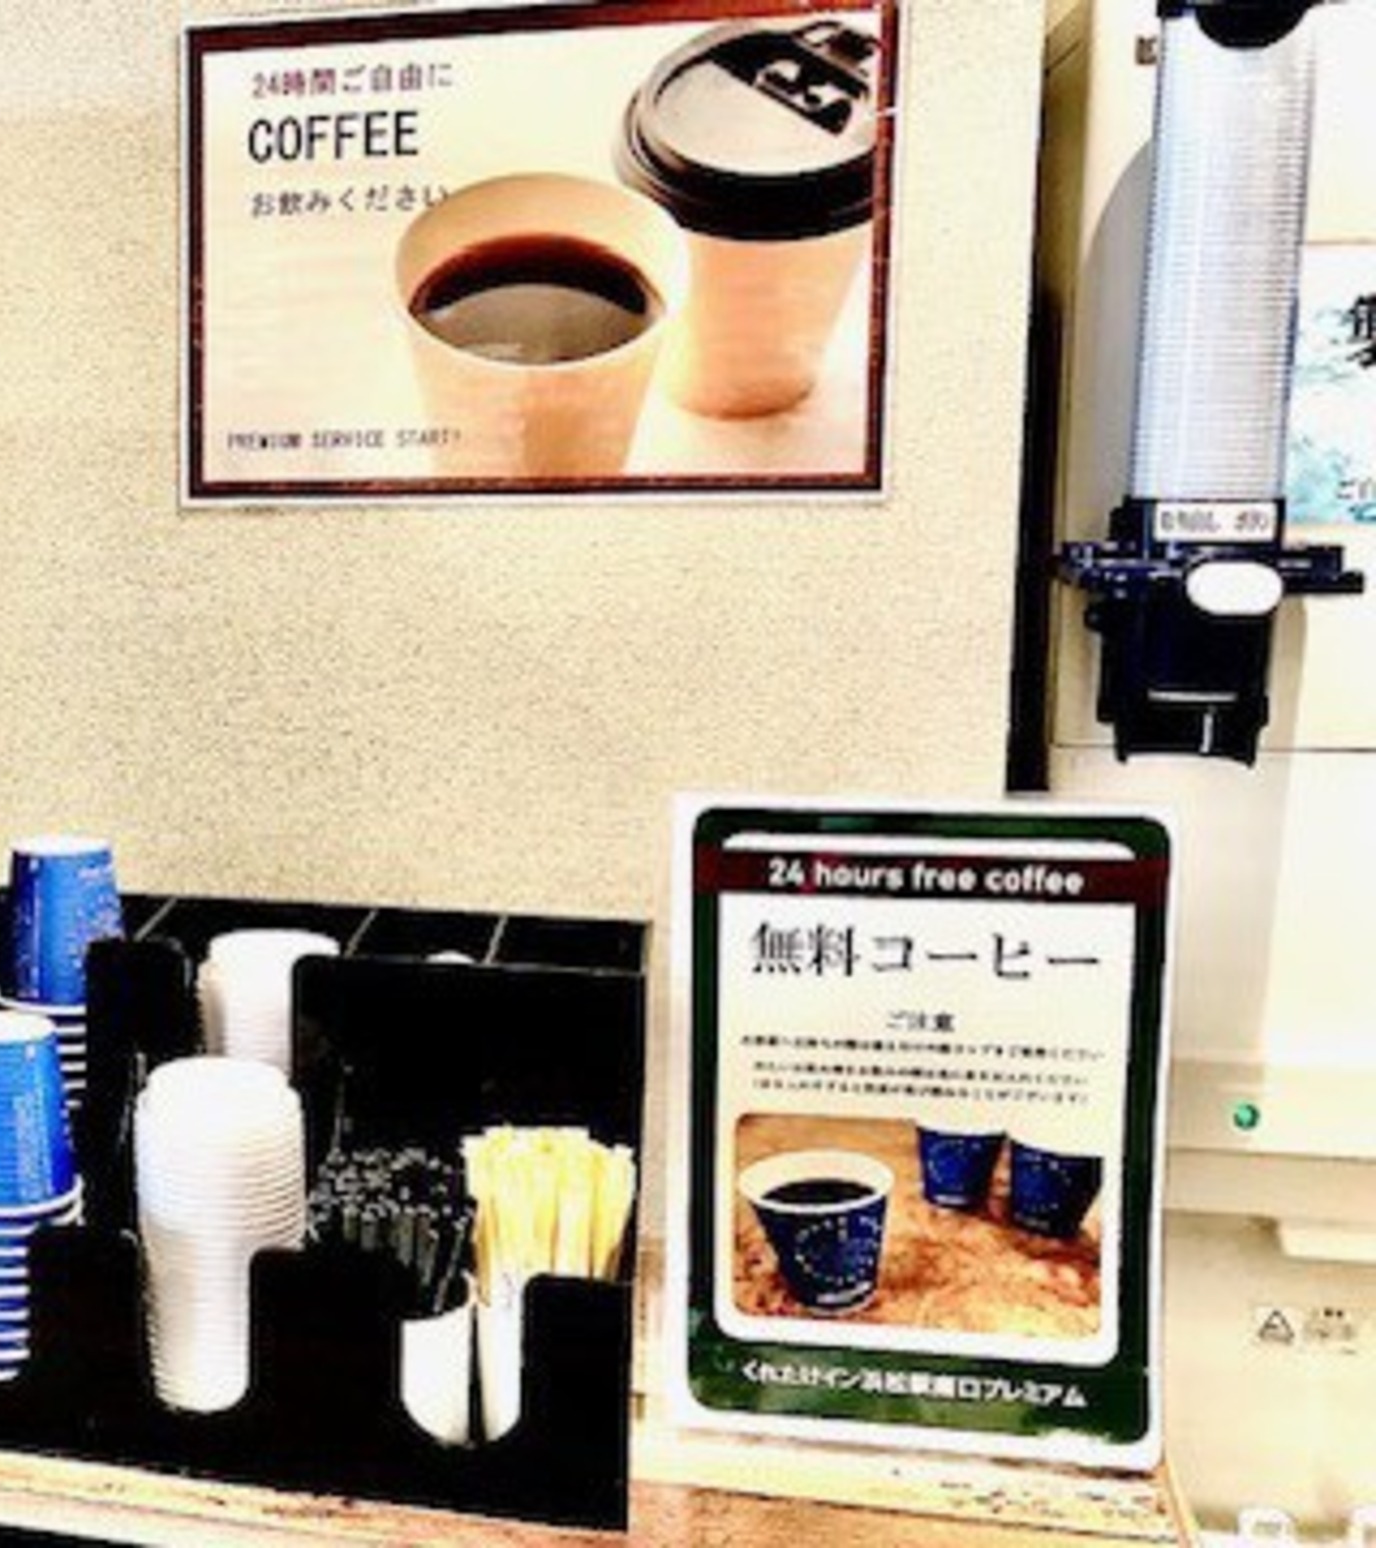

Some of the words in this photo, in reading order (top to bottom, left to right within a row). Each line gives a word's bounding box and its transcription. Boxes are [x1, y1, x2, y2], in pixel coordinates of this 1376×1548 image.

[251, 63, 454, 99] 24時間ご自由に
[247, 109, 420, 164] COFFEE
[251, 183, 451, 219] お飲みください
[226, 431, 302, 450] PREMIUM
[768, 858, 805, 886] 24
[813, 861, 905, 890] hours
[911, 864, 977, 892] free
[984, 866, 1085, 895] coffee
[751, 921, 1101, 979] 無料コーヒー
